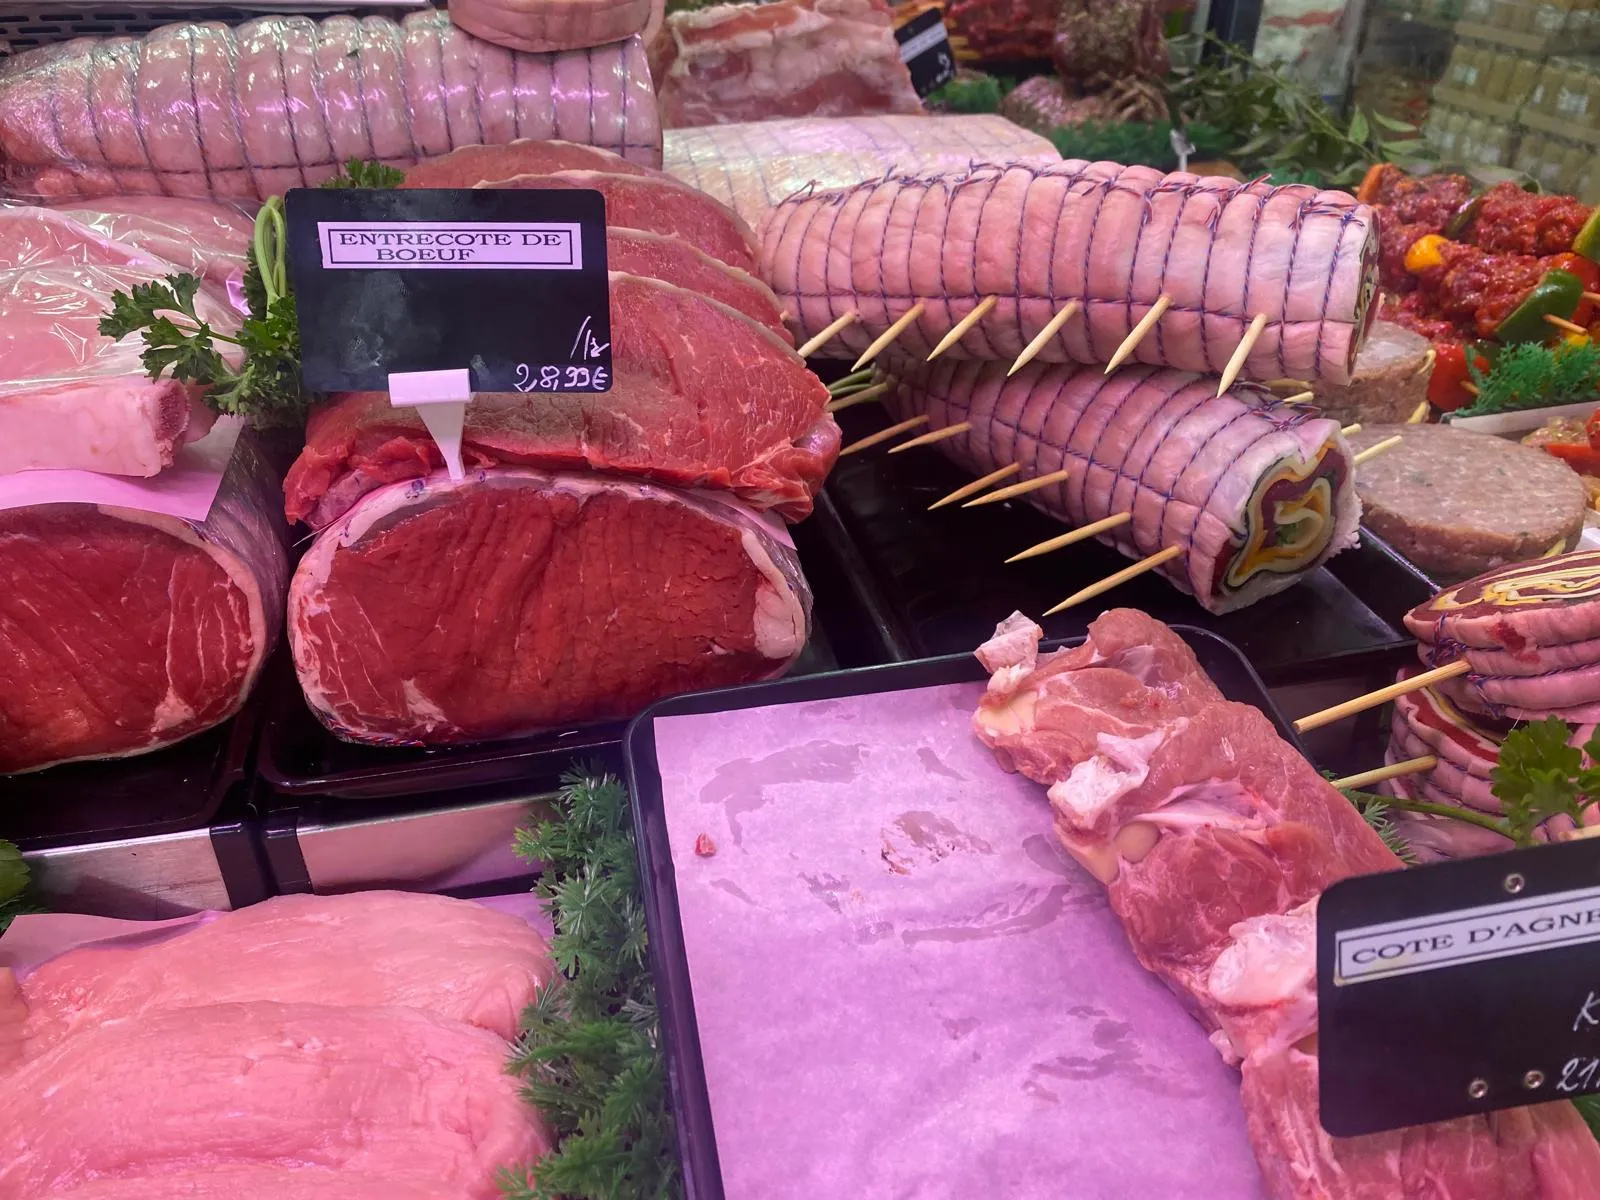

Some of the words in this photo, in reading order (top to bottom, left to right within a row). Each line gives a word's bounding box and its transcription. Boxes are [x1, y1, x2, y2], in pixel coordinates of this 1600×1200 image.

[339, 233, 512, 246] ENTRECOTE
[521, 233, 561, 246] DE
[376, 248, 475, 261] BOEUF
[1351, 934, 1453, 964] COTE
